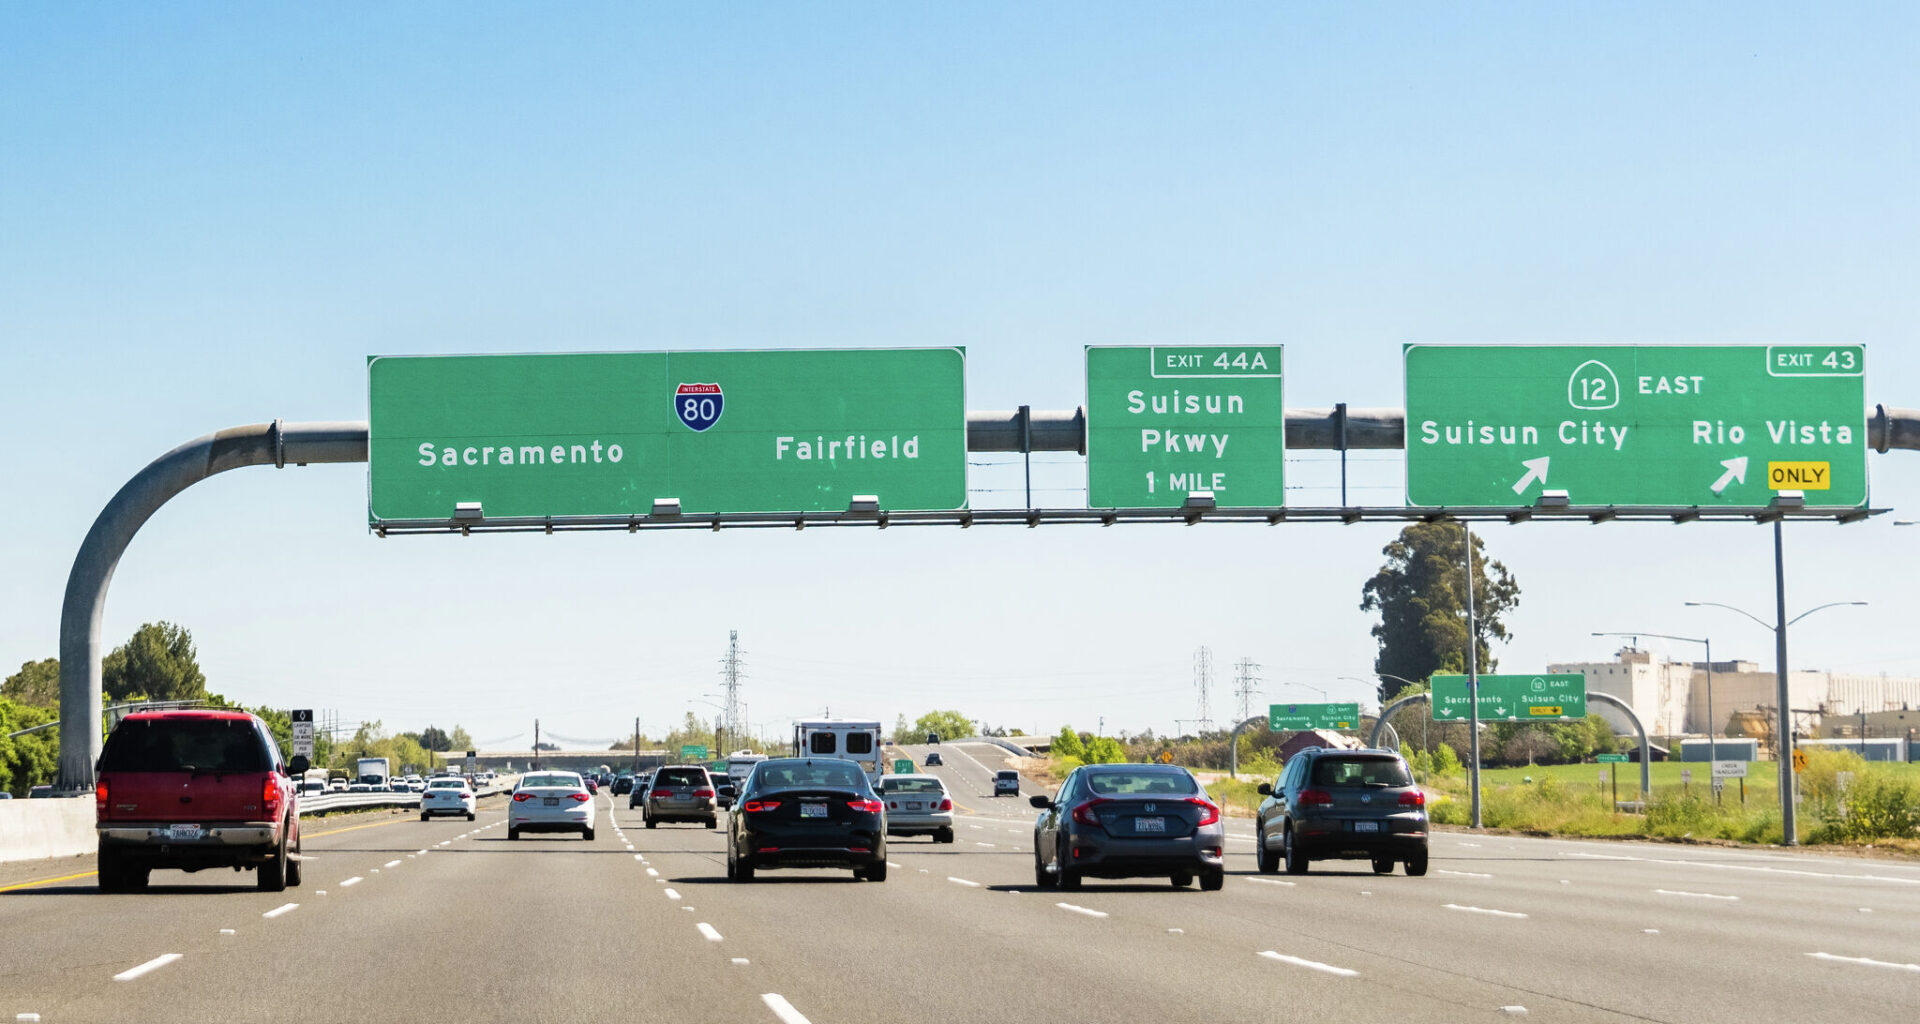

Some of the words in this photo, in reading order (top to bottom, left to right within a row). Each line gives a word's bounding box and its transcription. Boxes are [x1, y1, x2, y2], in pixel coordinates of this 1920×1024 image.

[1167, 354, 1203, 368] EXIT
[1213, 351, 1267, 370] 44A
[1777, 353, 1813, 367] EXIT
[1822, 351, 1855, 369] 43
[1580, 377, 1607, 401] 12
[1638, 375, 1704, 395] EAST
[683, 398, 716, 422] 80
[1127, 389, 1243, 414] Suisun
[1141, 429, 1230, 459] Pkwy
[1421, 420, 1538, 445] Suisun
[1558, 420, 1629, 451] City
[1693, 420, 1746, 445] Rio
[1766, 420, 1853, 445] Vista
[418, 439, 623, 466] Sacramento
[776, 435, 919, 460] Fairfield
[1146, 471, 1155, 493] 1
[1169, 472, 1226, 491] MILE
[1772, 468, 1825, 484] ONLY
[1521, 695, 1555, 704] Suisun
[1558, 695, 1580, 704] City
